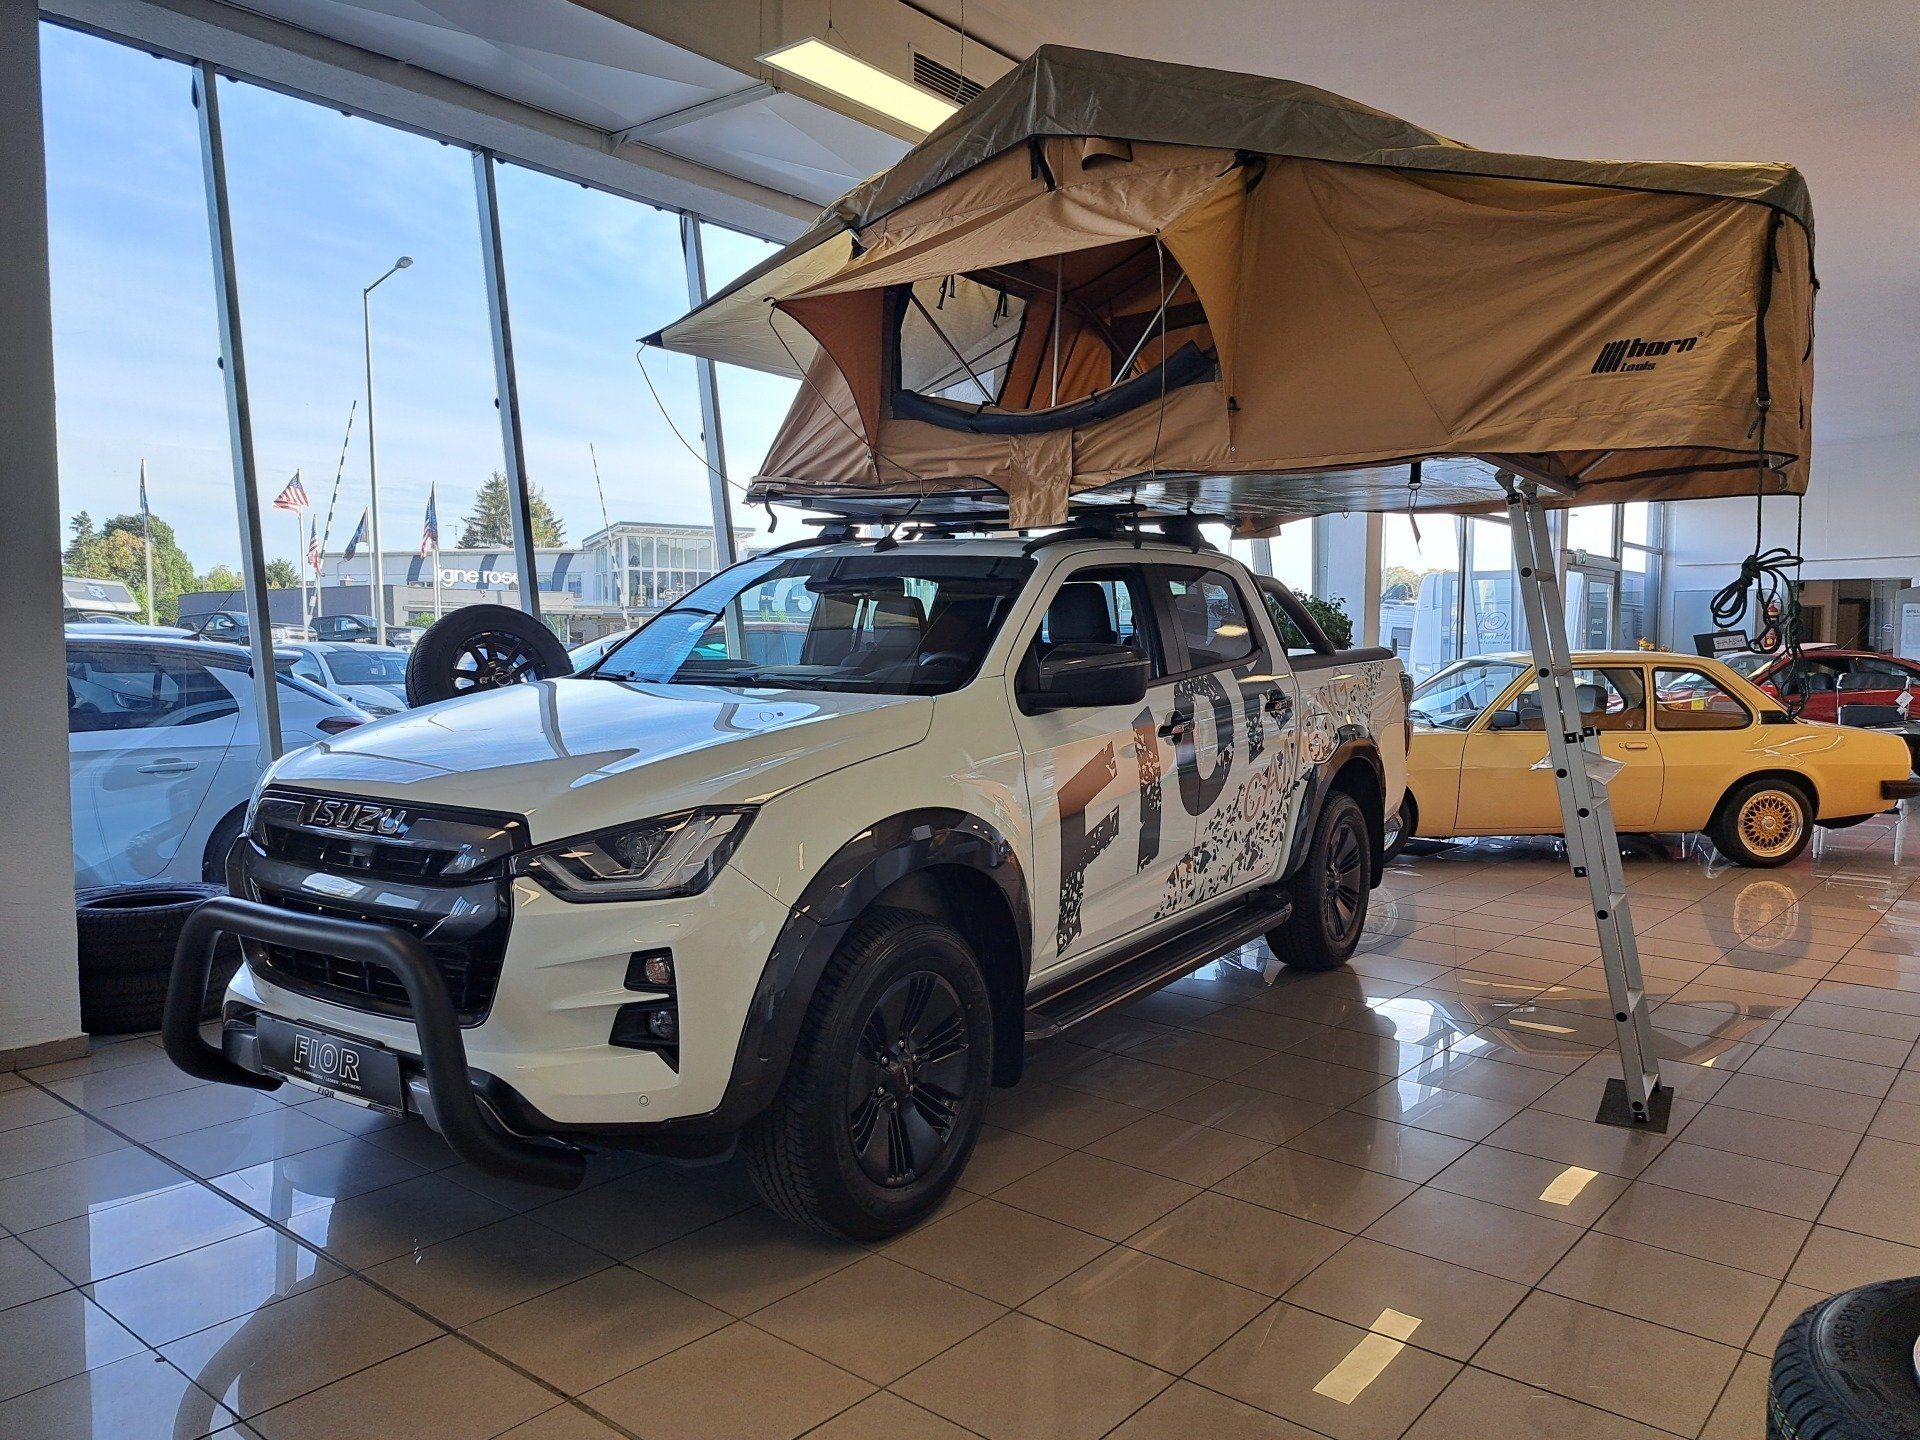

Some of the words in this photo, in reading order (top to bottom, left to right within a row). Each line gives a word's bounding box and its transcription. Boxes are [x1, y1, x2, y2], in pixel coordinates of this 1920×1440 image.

[438, 564, 480, 587] igne
[309, 799, 407, 834] ISUZU
[1056, 660, 1294, 957] FIOR
[294, 1034, 360, 1081] FIOR
[317, 1086, 335, 1098] FIOR
